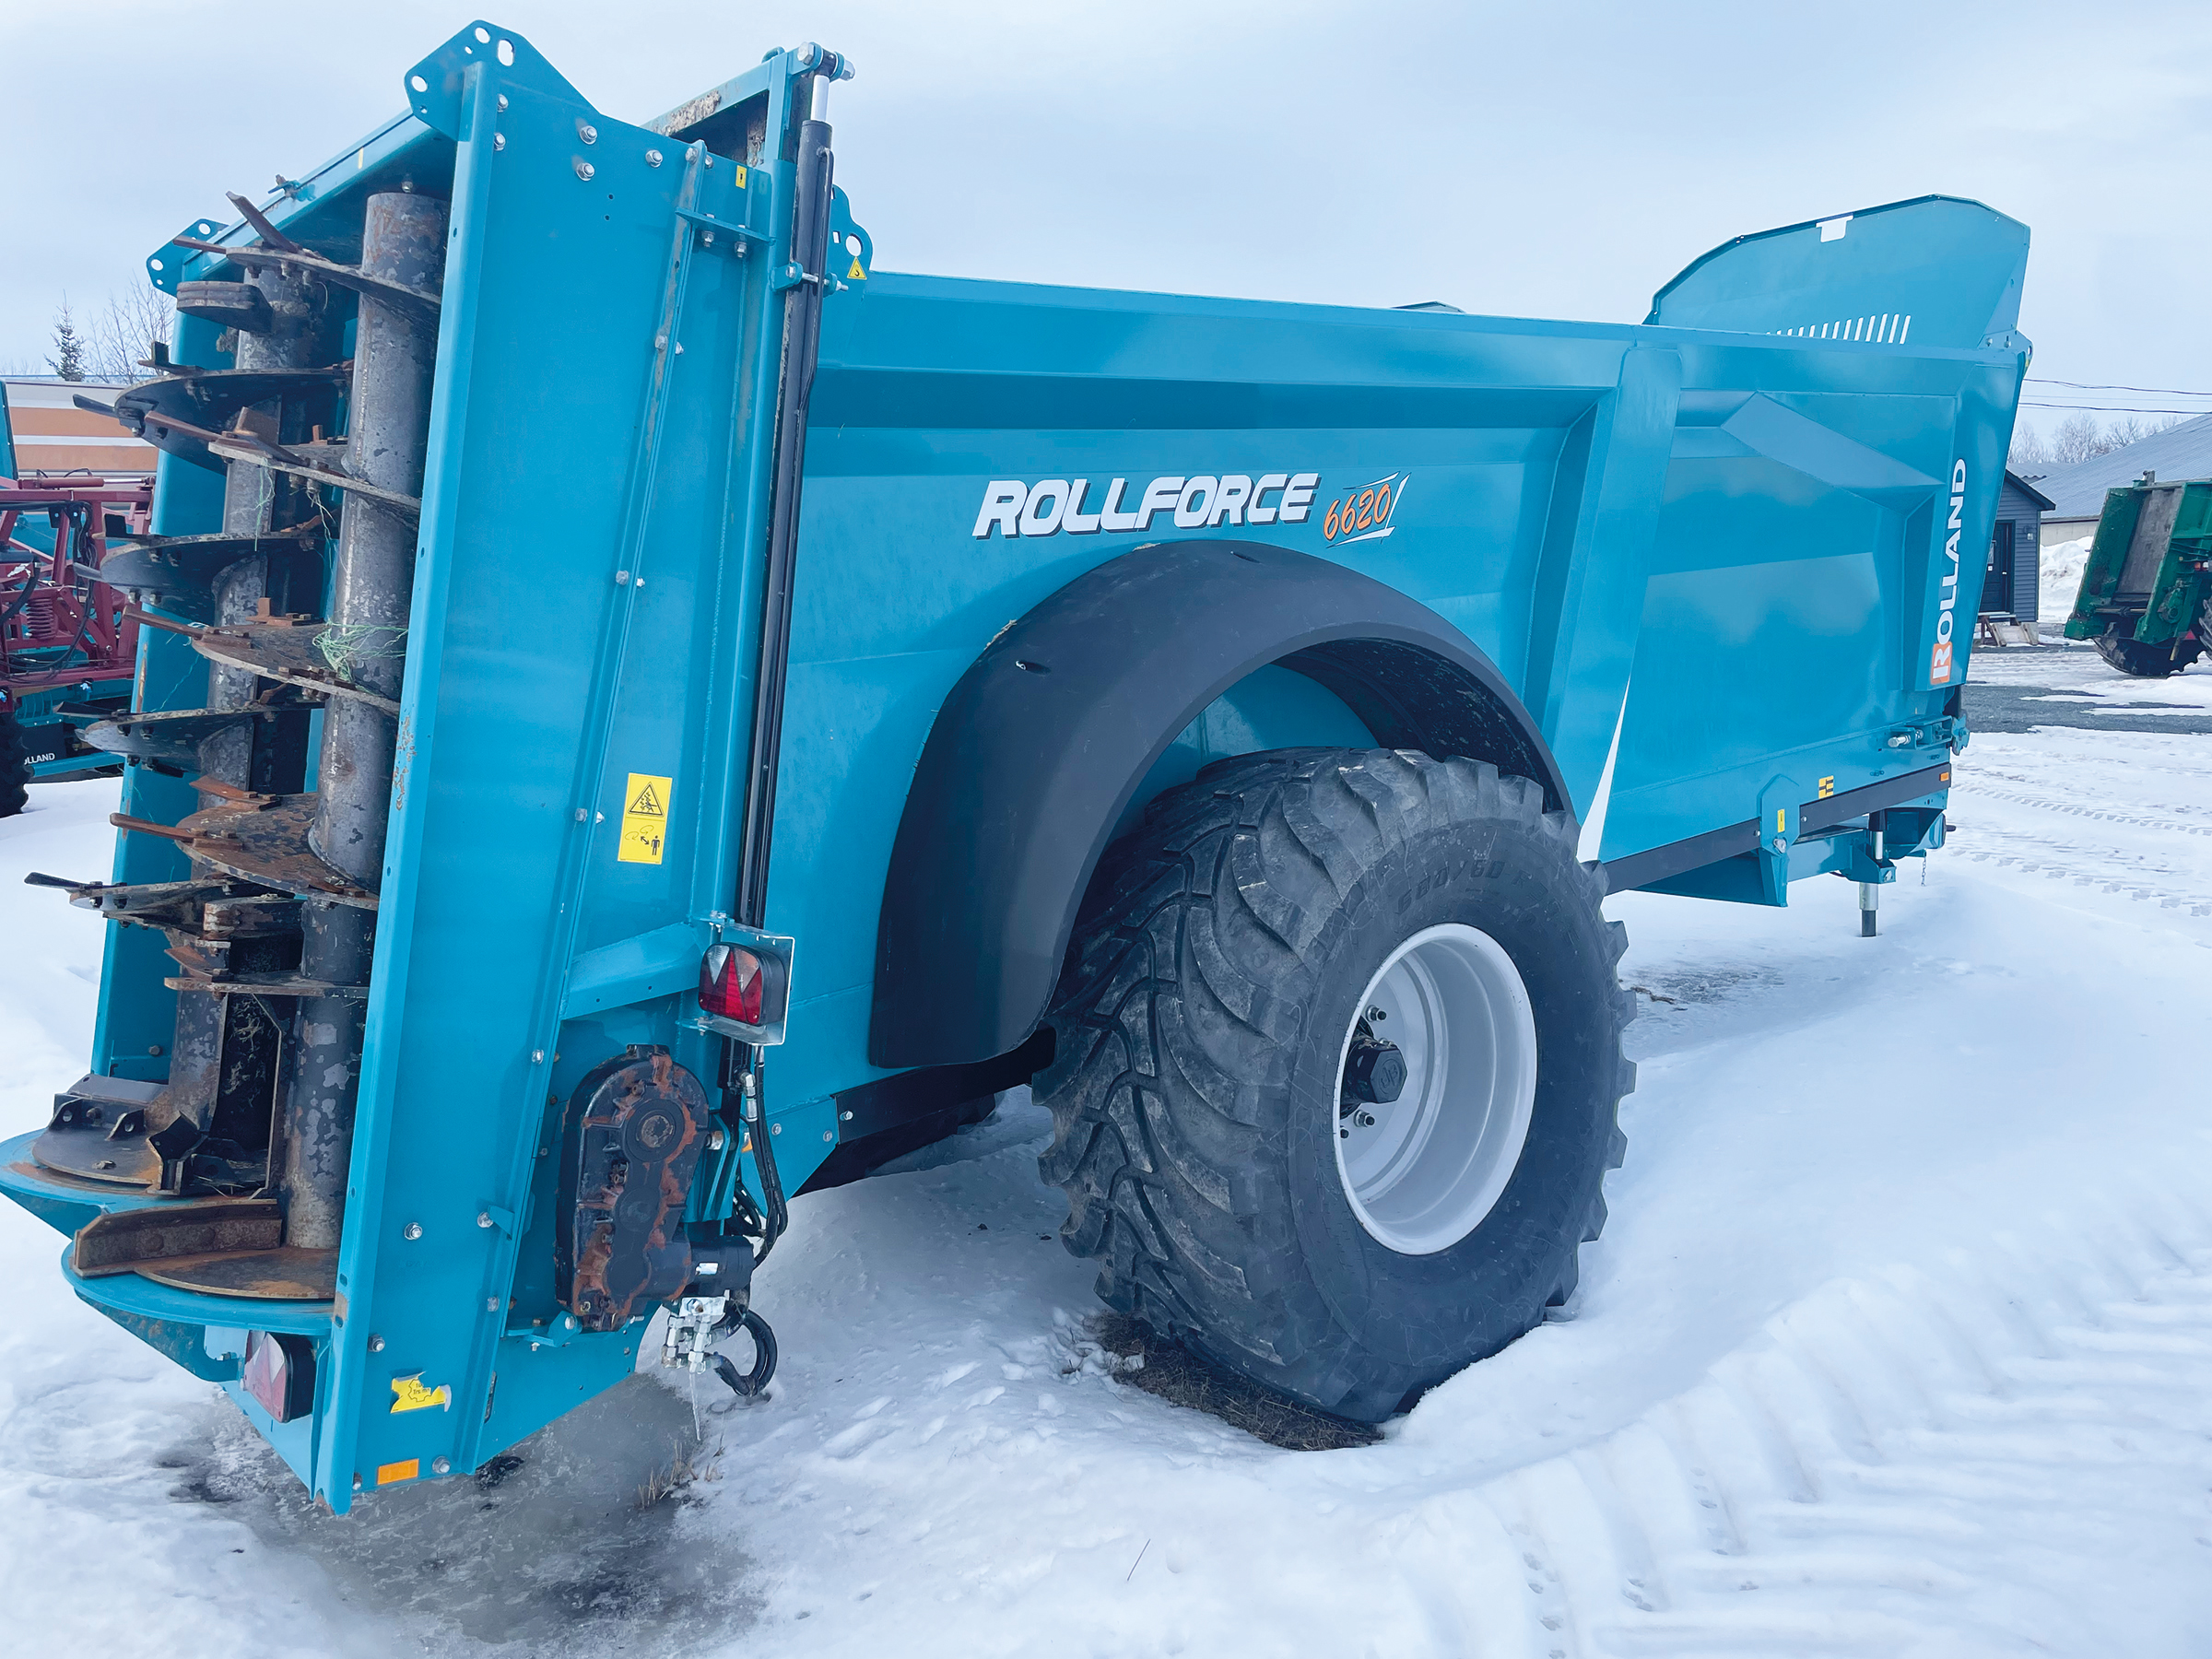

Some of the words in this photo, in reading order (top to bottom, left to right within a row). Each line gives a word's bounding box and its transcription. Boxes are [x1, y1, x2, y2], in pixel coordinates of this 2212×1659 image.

[972, 472, 1322, 540] ROLLFORCE
[1323, 482, 1393, 541] 6620
[1932, 458, 1967, 680] ROLLAND
